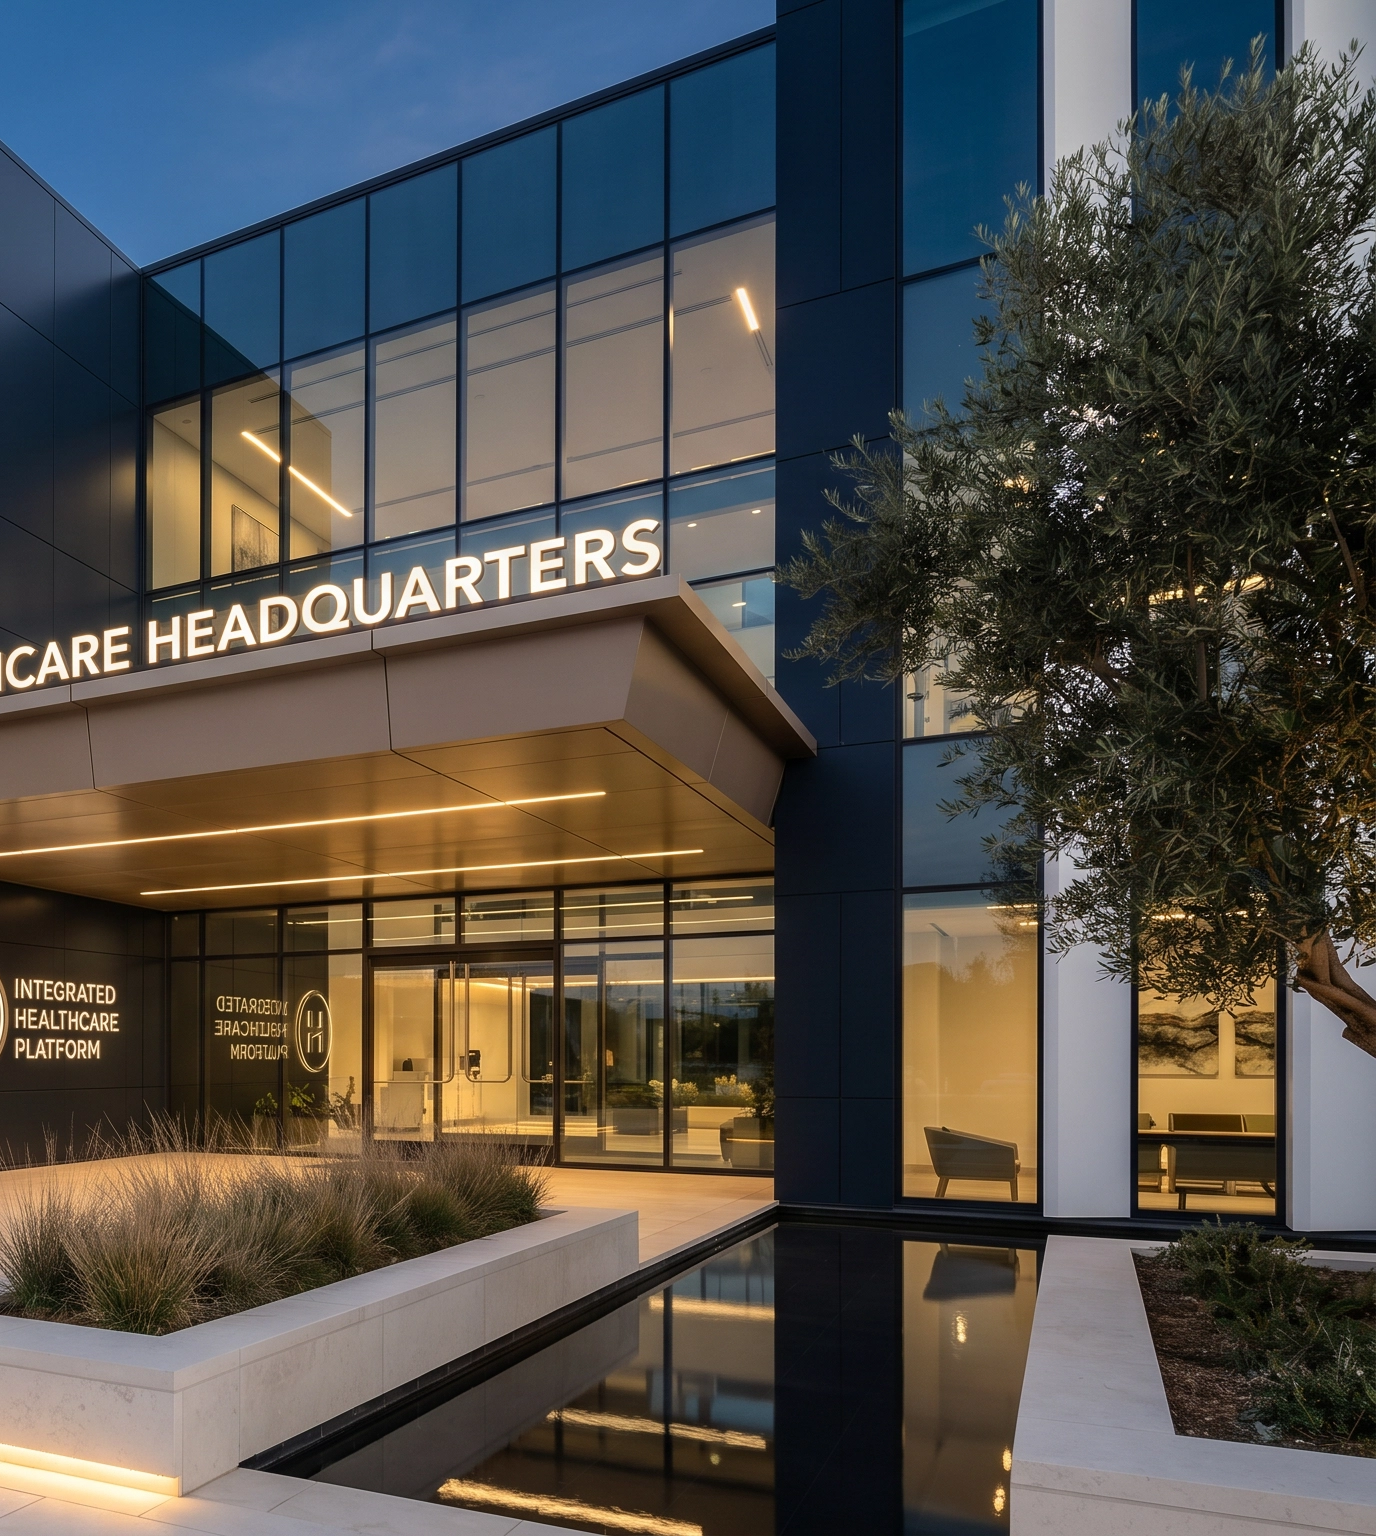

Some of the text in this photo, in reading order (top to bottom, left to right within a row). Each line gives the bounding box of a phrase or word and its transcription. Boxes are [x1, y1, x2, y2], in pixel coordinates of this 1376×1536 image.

[148, 519, 661, 664] HEADQUARTERS
[14, 978, 117, 1005] INTEGRATED
[14, 1008, 120, 1032] HEALTHCARE
[14, 1038, 101, 1060] PLATFORM
